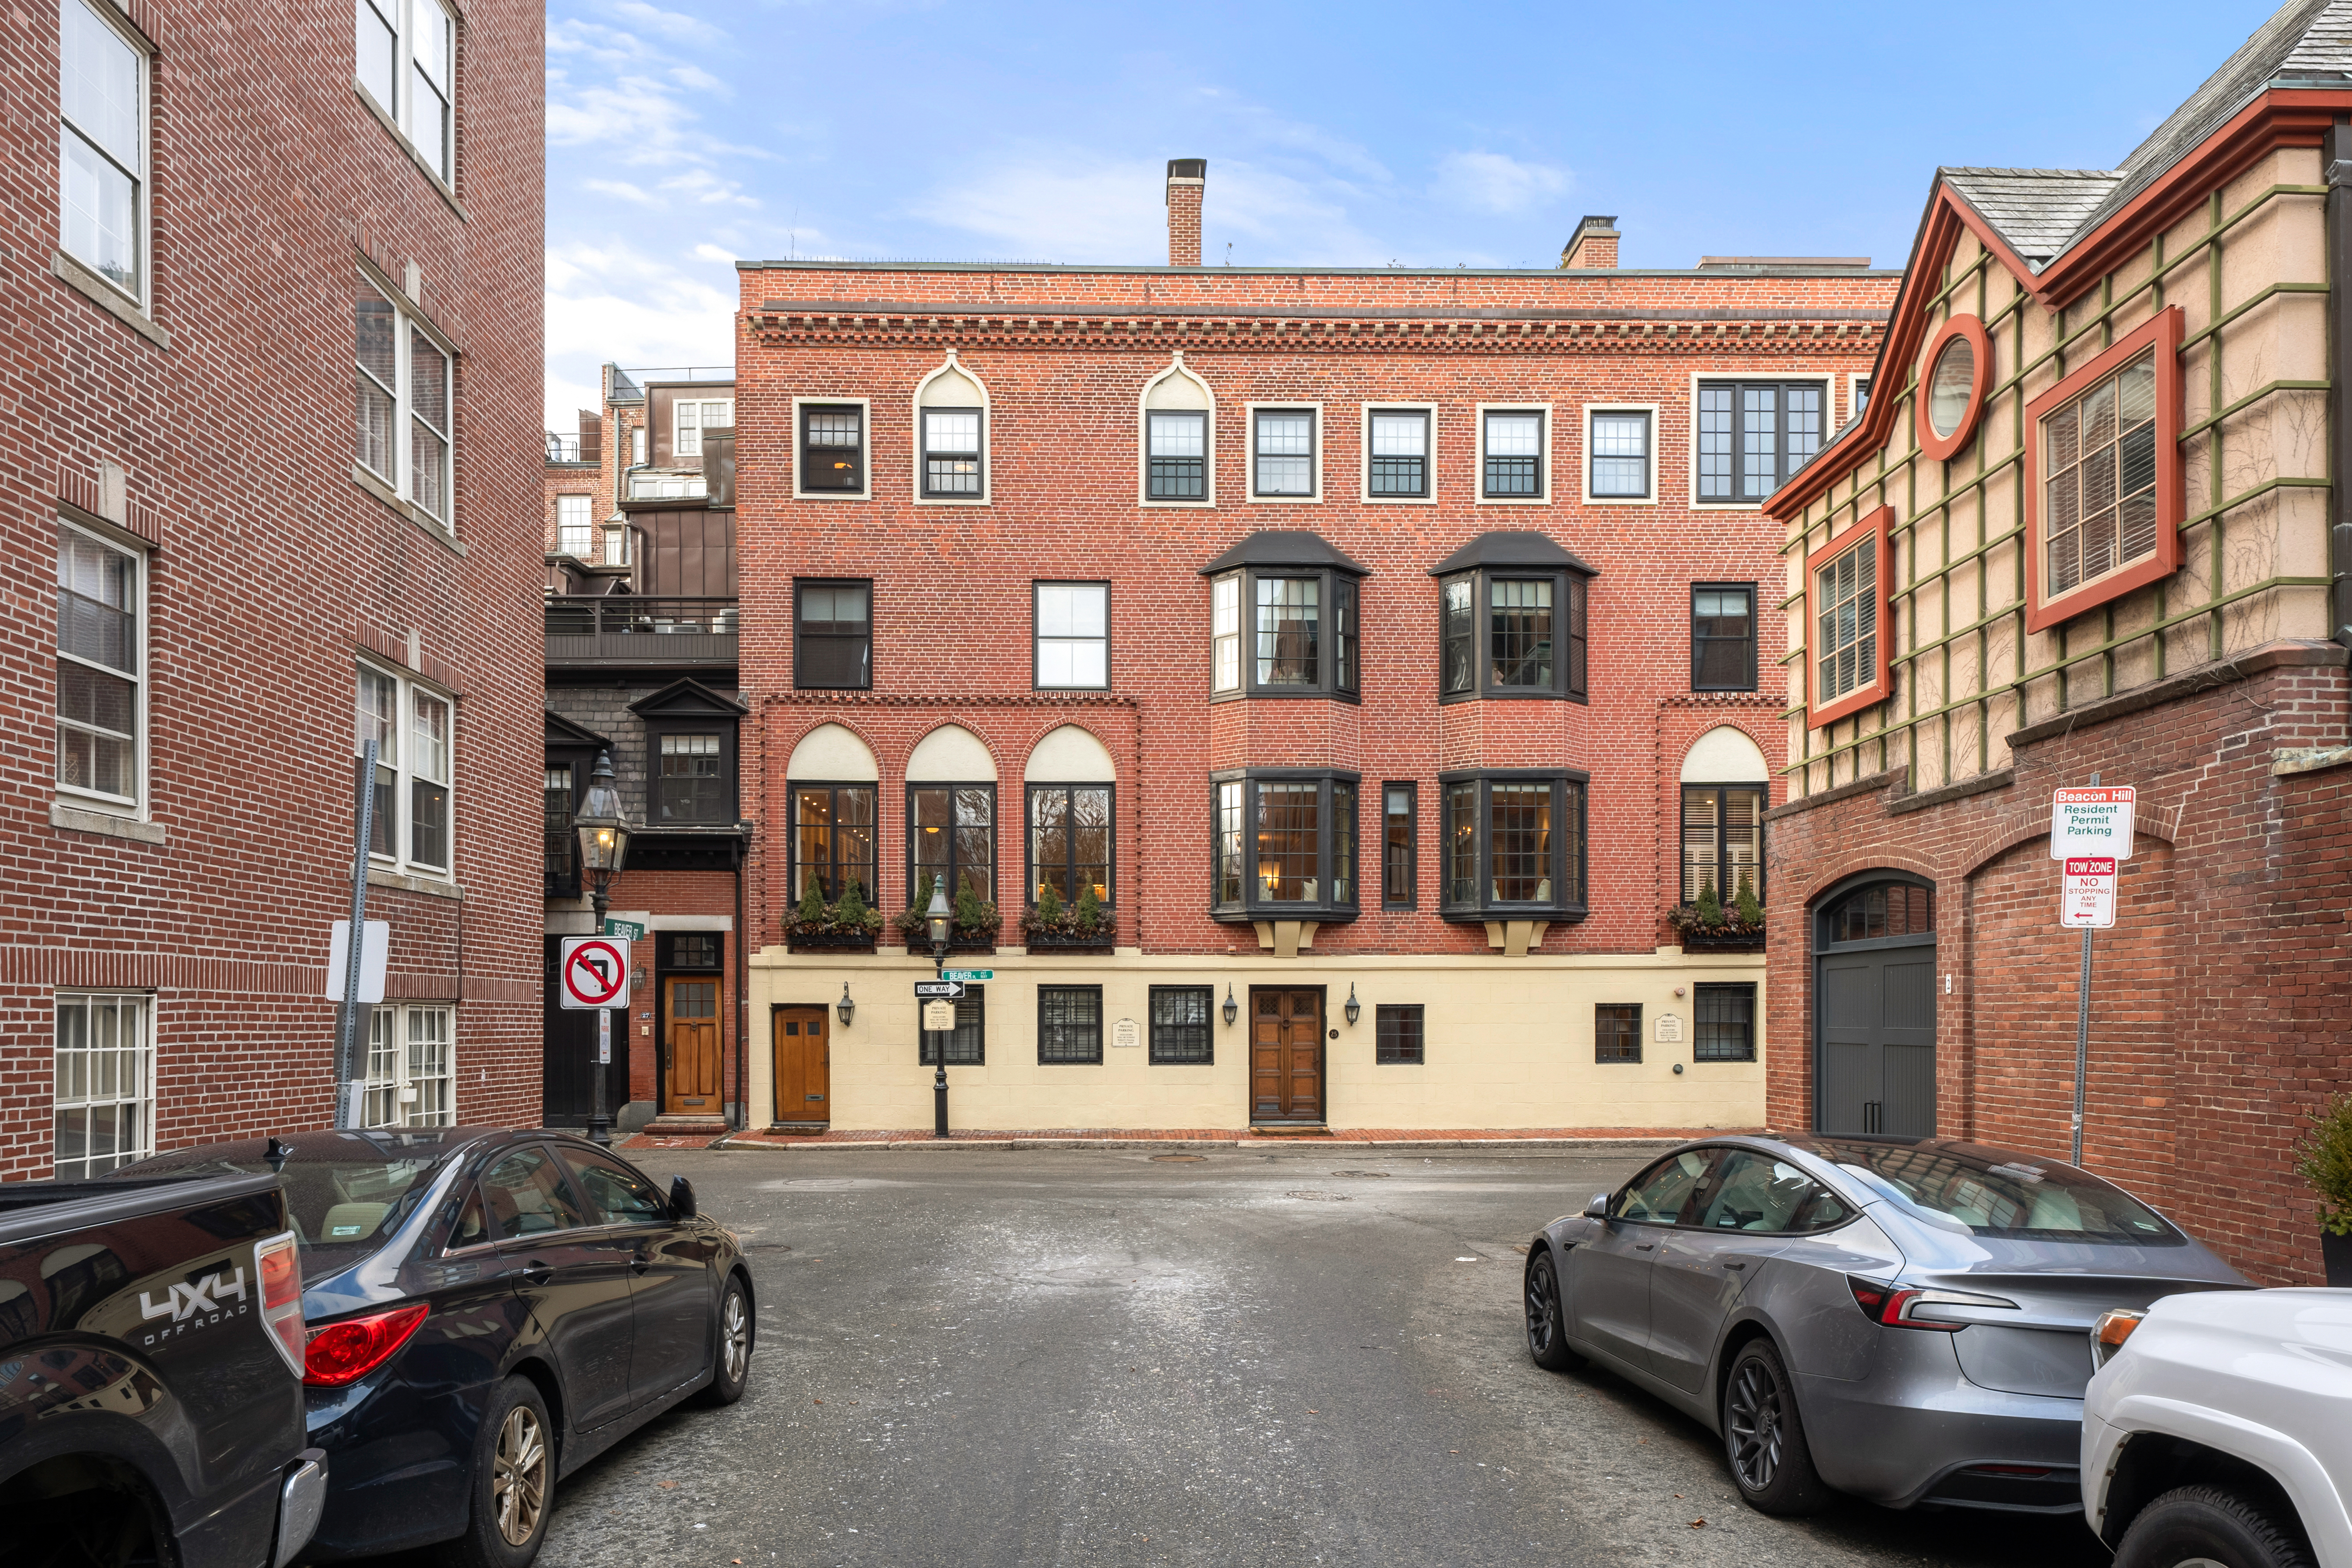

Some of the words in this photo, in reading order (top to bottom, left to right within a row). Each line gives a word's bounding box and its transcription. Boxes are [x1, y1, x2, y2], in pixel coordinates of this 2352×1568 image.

[2058, 791, 2106, 802] Beacon
[2112, 790, 2132, 801] Hill
[2065, 805, 2117, 814] Resident
[2071, 815, 2109, 824] Permit
[2067, 826, 2112, 836] Parking
[2069, 862, 2088, 873] TOW
[2089, 862, 2112, 872] ZONE
[2080, 878, 2098, 886] NO
[614, 923, 632, 937] BEAVER
[633, 929, 639, 938] ST
[949, 972, 972, 980] BEAVER
[1947, 979, 1950, 990] 2
[139, 1267, 246, 1322] 4X4
[145, 1324, 185, 1345] OFF
[195, 1305, 247, 1329] ROAD
